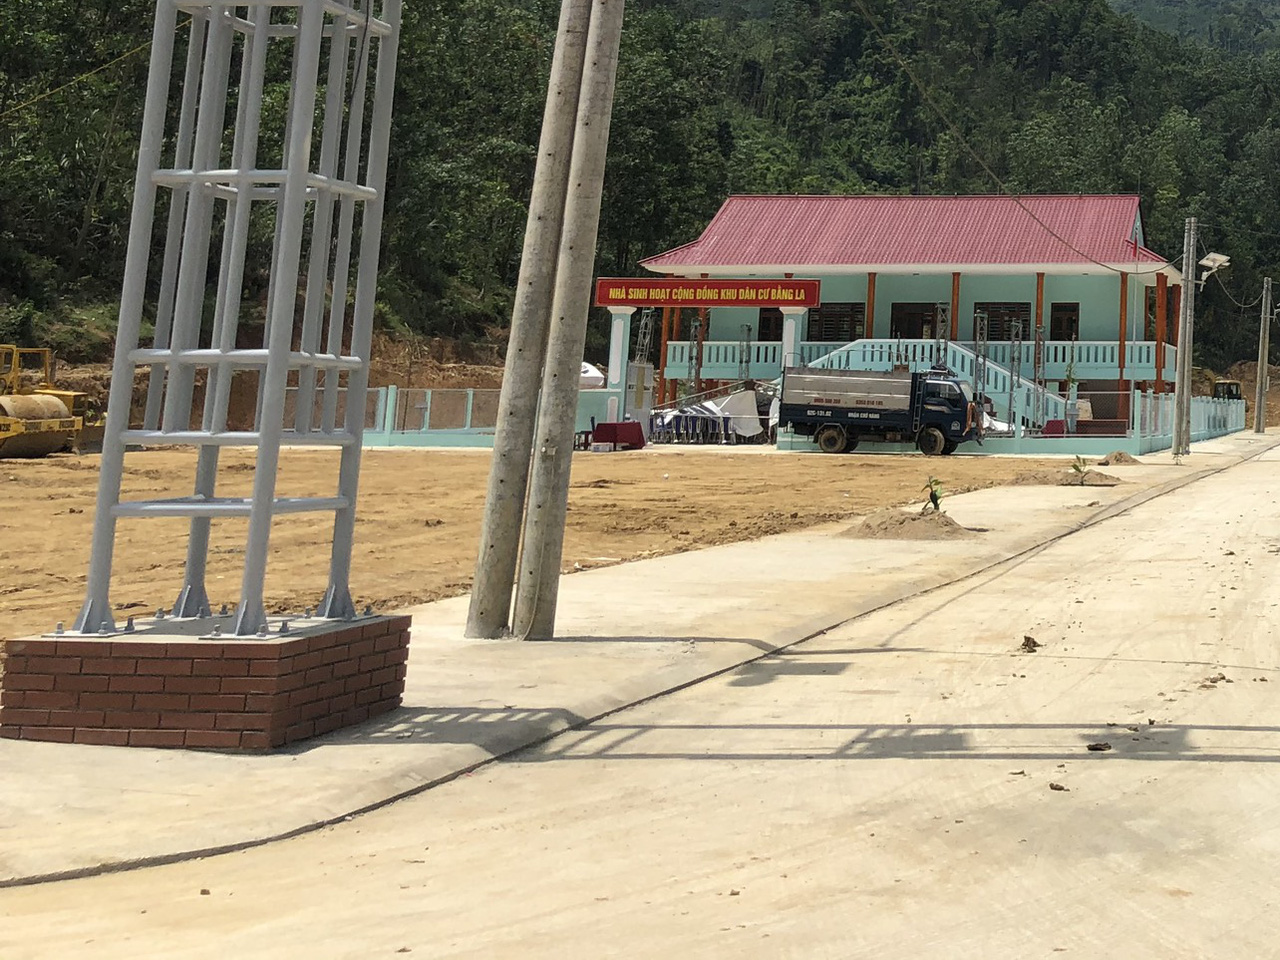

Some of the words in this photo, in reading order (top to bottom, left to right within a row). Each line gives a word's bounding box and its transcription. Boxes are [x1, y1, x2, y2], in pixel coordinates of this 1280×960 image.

[608, 286, 627, 299] NHÀ
[628, 288, 648, 300] SINH
[649, 288, 671, 302] HOẠT
[672, 286, 694, 302] CỘNG
[720, 288, 737, 300] KHU
[738, 286, 757, 300] DÂN
[758, 287, 771, 300] CƯ
[771, 285, 794, 300] BẰNG
[795, 289, 806, 300] LA
